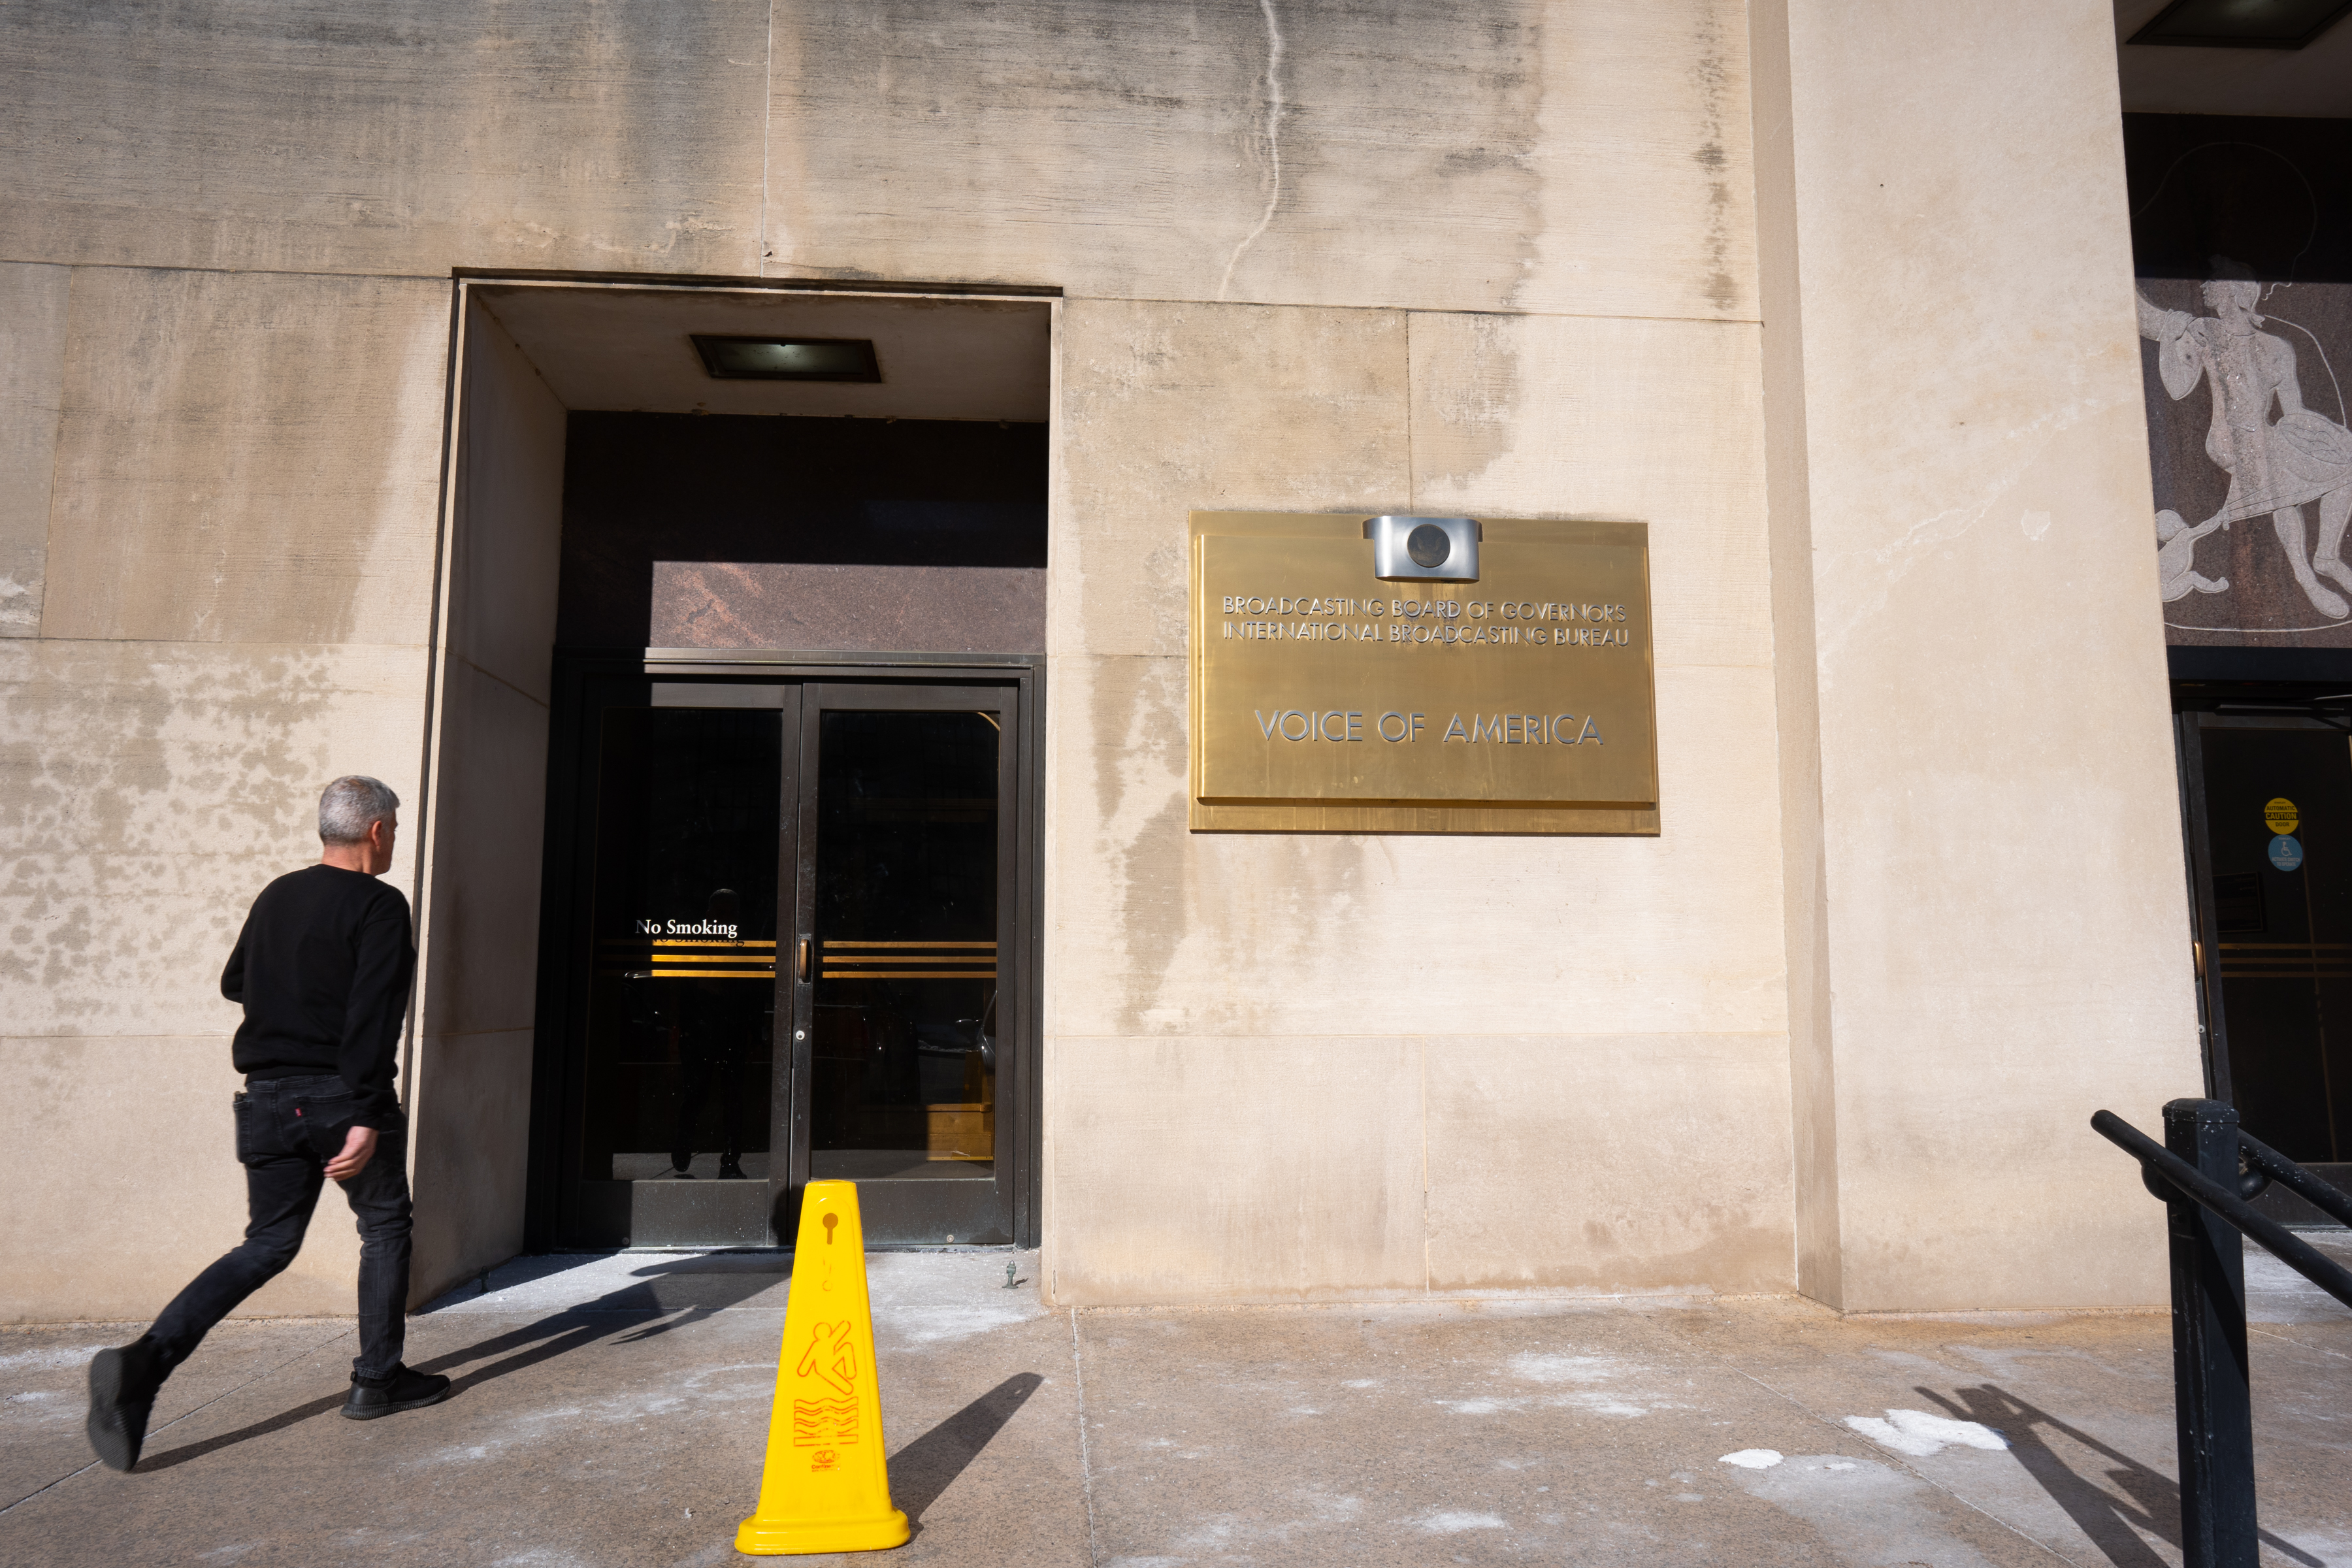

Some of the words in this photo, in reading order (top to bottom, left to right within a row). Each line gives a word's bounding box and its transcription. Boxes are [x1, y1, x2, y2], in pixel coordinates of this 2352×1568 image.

[1223, 596, 1384, 617] BROADCASTING
[1392, 599, 1460, 619] BOARD
[1467, 601, 1494, 619] OF
[1501, 602, 1627, 623] GOVERNORS
[1223, 621, 1383, 642] INTERNATIONAL
[1390, 625, 1548, 645] BROADCASTING
[1554, 628, 1629, 647] BUREAU
[1254, 710, 1363, 742] VOICE
[1378, 711, 1425, 742] OF
[1443, 713, 1604, 745] AMERICA
[635, 919, 661, 934] No
[666, 919, 738, 939] Smoking
